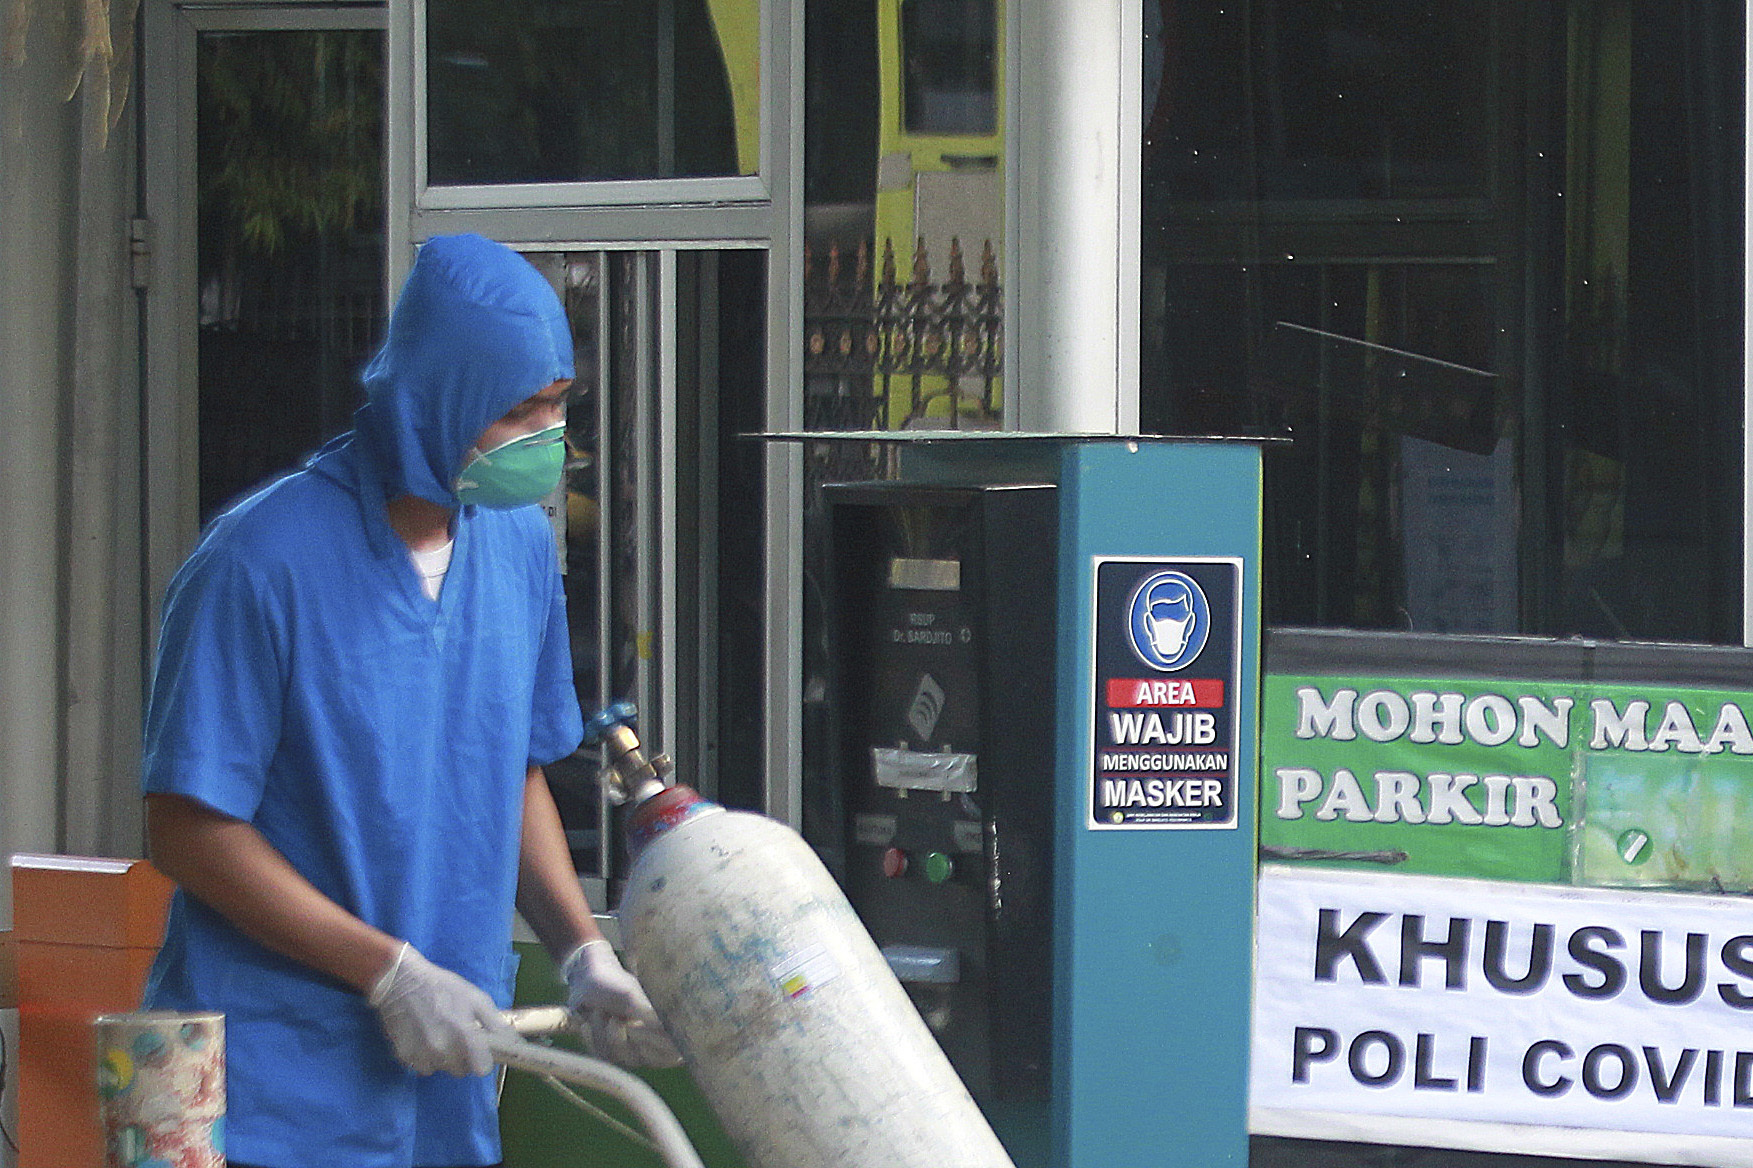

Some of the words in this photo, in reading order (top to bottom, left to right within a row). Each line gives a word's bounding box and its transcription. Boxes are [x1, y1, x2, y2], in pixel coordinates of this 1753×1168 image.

[1136, 682, 1196, 706] AREA
[1112, 713, 1216, 745] WAJIB
[1294, 687, 1574, 750] MOHON
[1103, 754, 1227, 771] MENGGUNAKAN
[1104, 780, 1223, 808] MASKER
[1274, 767, 1564, 829] PARKIR
[1290, 1026, 1489, 1095] POLI
